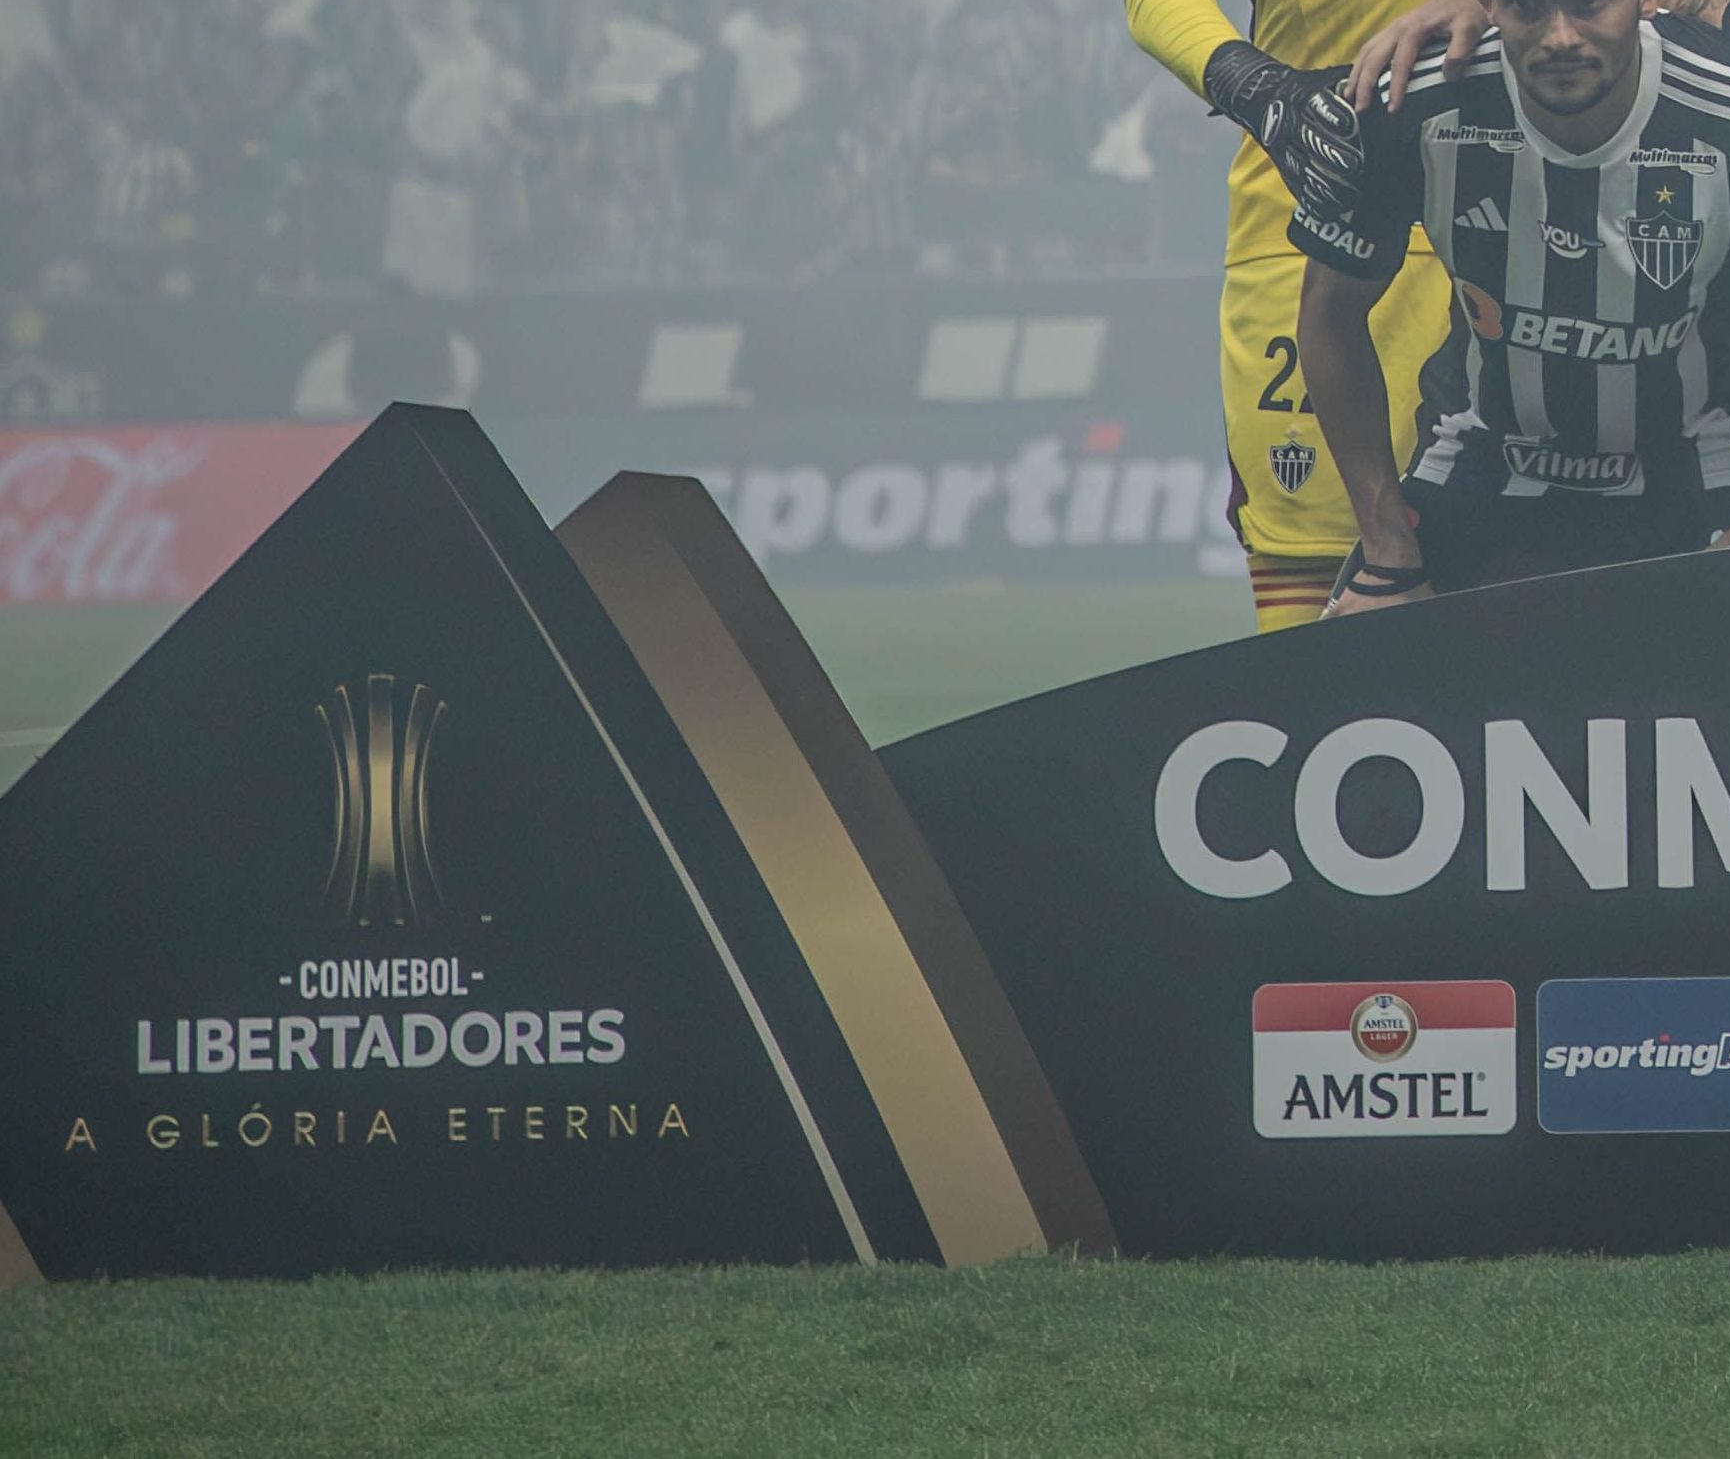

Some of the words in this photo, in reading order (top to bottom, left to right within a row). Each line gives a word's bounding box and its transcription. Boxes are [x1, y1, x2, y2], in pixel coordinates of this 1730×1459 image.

[1437, 126, 1525, 141] Multimarcas
[1629, 149, 1718, 166] Multimarcas
[1539, 221, 1580, 250] YOU
[1638, 224, 1692, 239] CAM
[1510, 311, 1694, 361] BETANO
[1258, 336, 1315, 414] 2
[1511, 447, 1625, 480] Vilma
[1364, 1018, 1405, 1029] AMSTEL
[137, 1008, 626, 1074] LIBERTADORES
[65, 1117, 97, 1153] A
[147, 1103, 398, 1149] GLÓRIA
[448, 1104, 690, 1141] ETERNA
